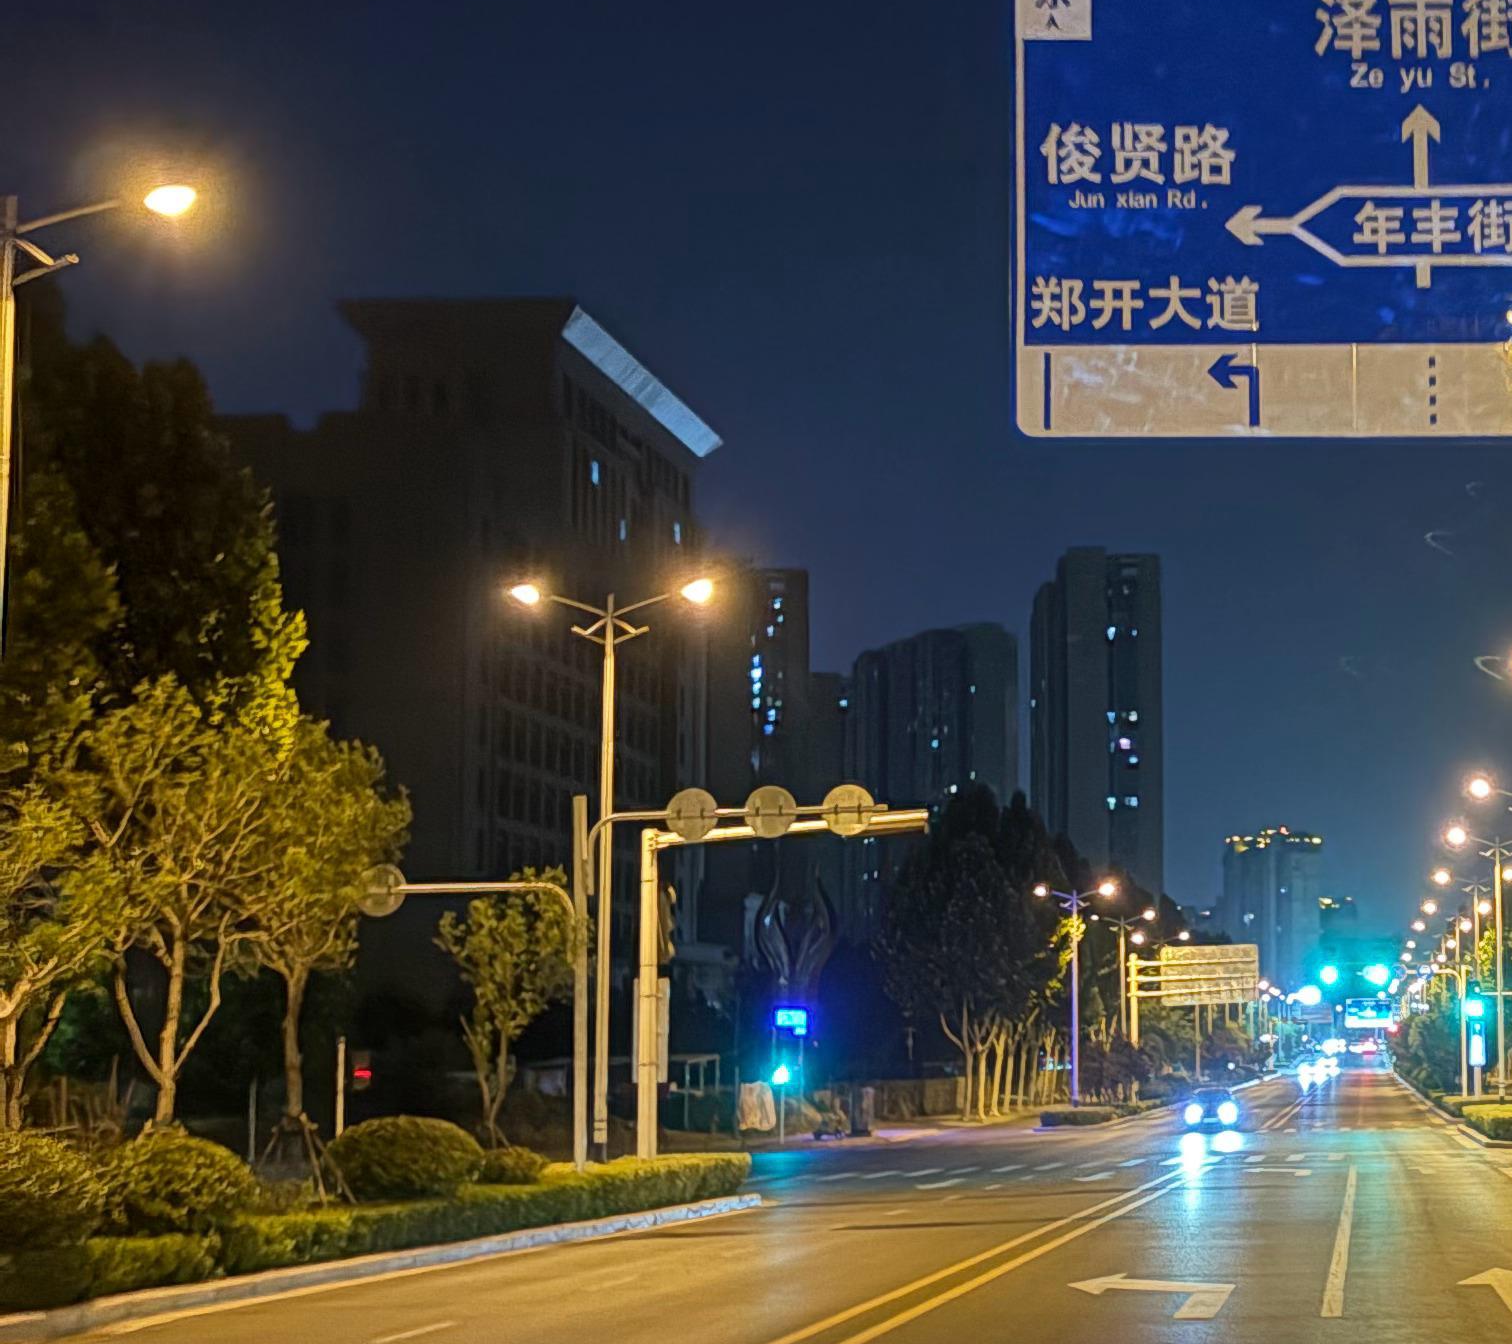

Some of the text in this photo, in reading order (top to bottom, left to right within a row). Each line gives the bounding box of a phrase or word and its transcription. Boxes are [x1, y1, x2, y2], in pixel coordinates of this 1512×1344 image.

[1400, 66, 1432, 94] yu
[1040, 122, 1236, 185] 俊贤路
[1068, 189, 1105, 209] Jun
[1116, 189, 1157, 209] xian
[1031, 275, 1260, 332] 郑开大道
